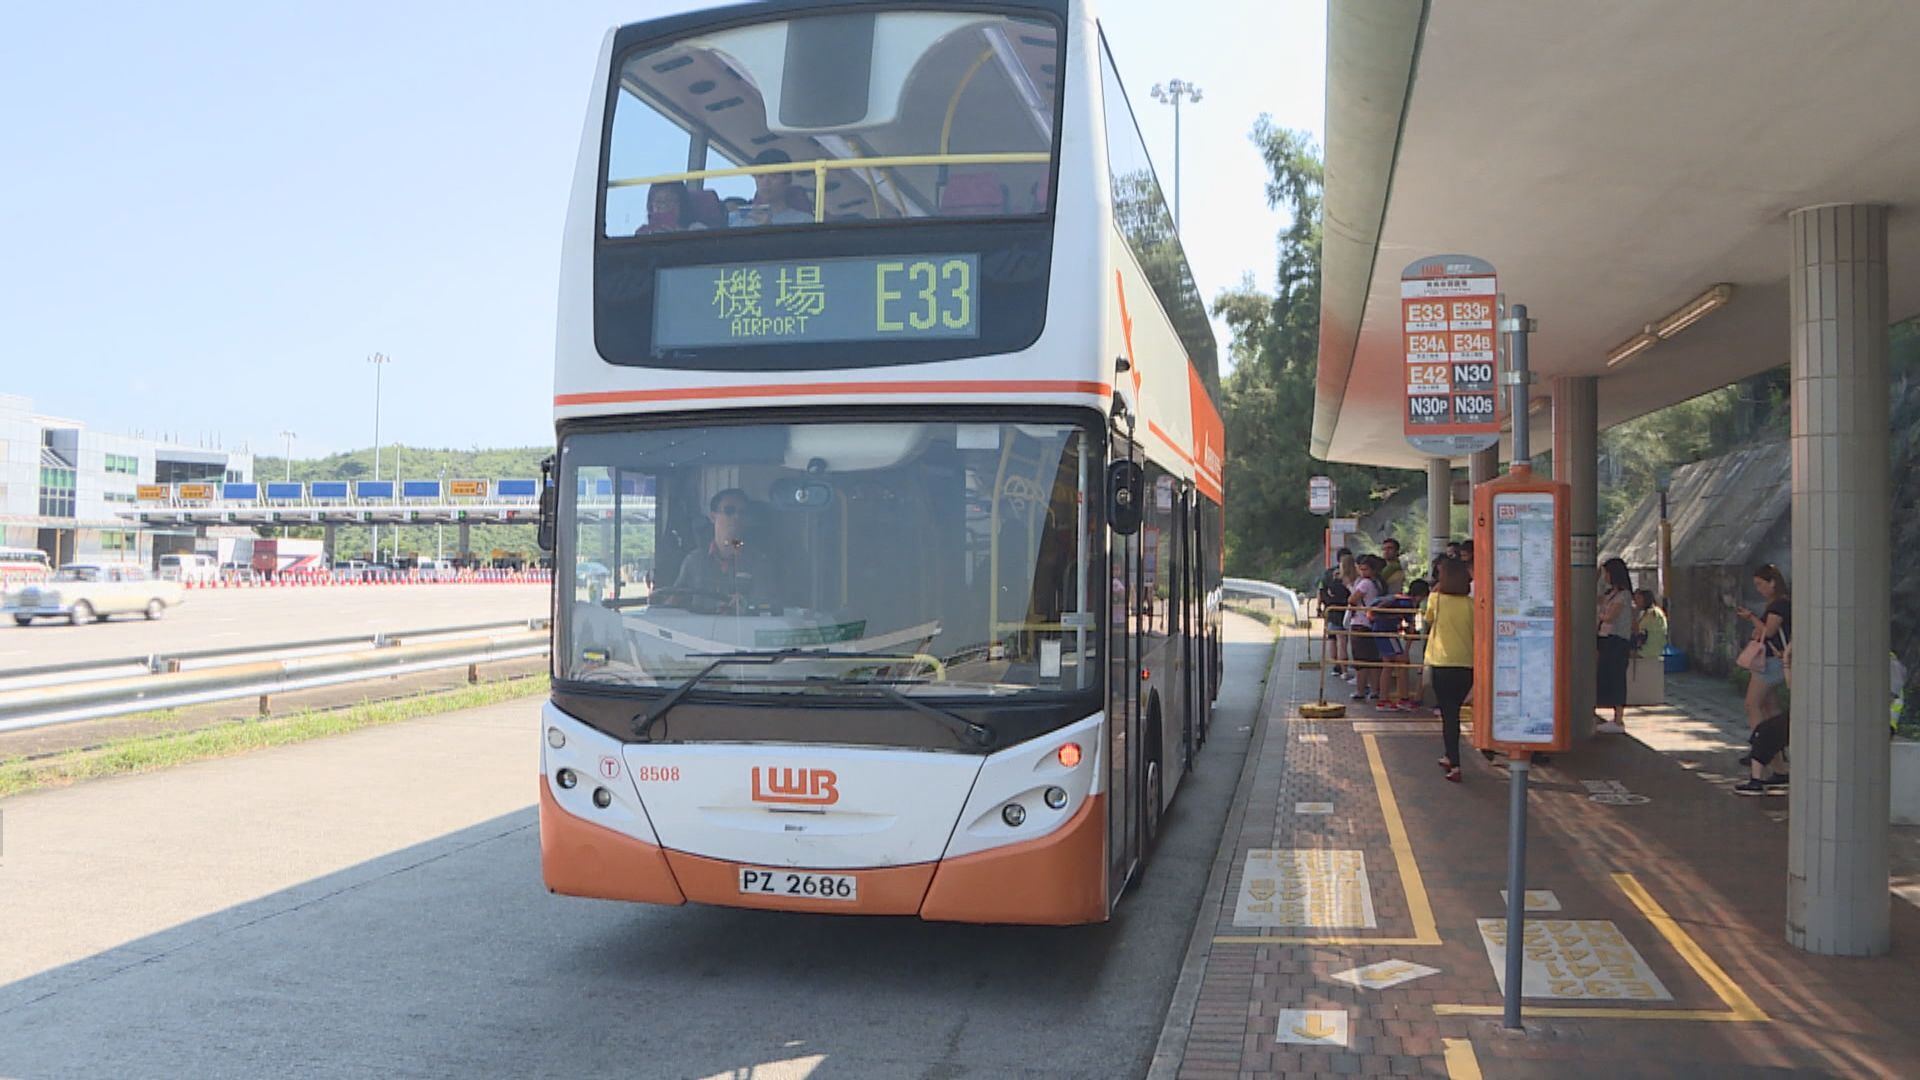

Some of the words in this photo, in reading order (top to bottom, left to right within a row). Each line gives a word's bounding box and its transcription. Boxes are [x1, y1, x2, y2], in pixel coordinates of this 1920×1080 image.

[711, 266, 825, 319] 機場
[876, 260, 970, 332] E33
[1408, 303, 1445, 322] E33
[1452, 302, 1489, 320] E33P
[731, 316, 809, 337] AIRPORT
[1409, 335, 1446, 352] E34A
[1453, 333, 1491, 350] E34B
[1410, 366, 1447, 384] E42
[1454, 364, 1491, 382] N30
[1411, 397, 1448, 416] N30P
[1455, 396, 1493, 414] N30S
[640, 766, 680, 782] 8508
[752, 766, 839, 805] LWB
[743, 871, 774, 892] PZ
[787, 874, 851, 897] 2686
